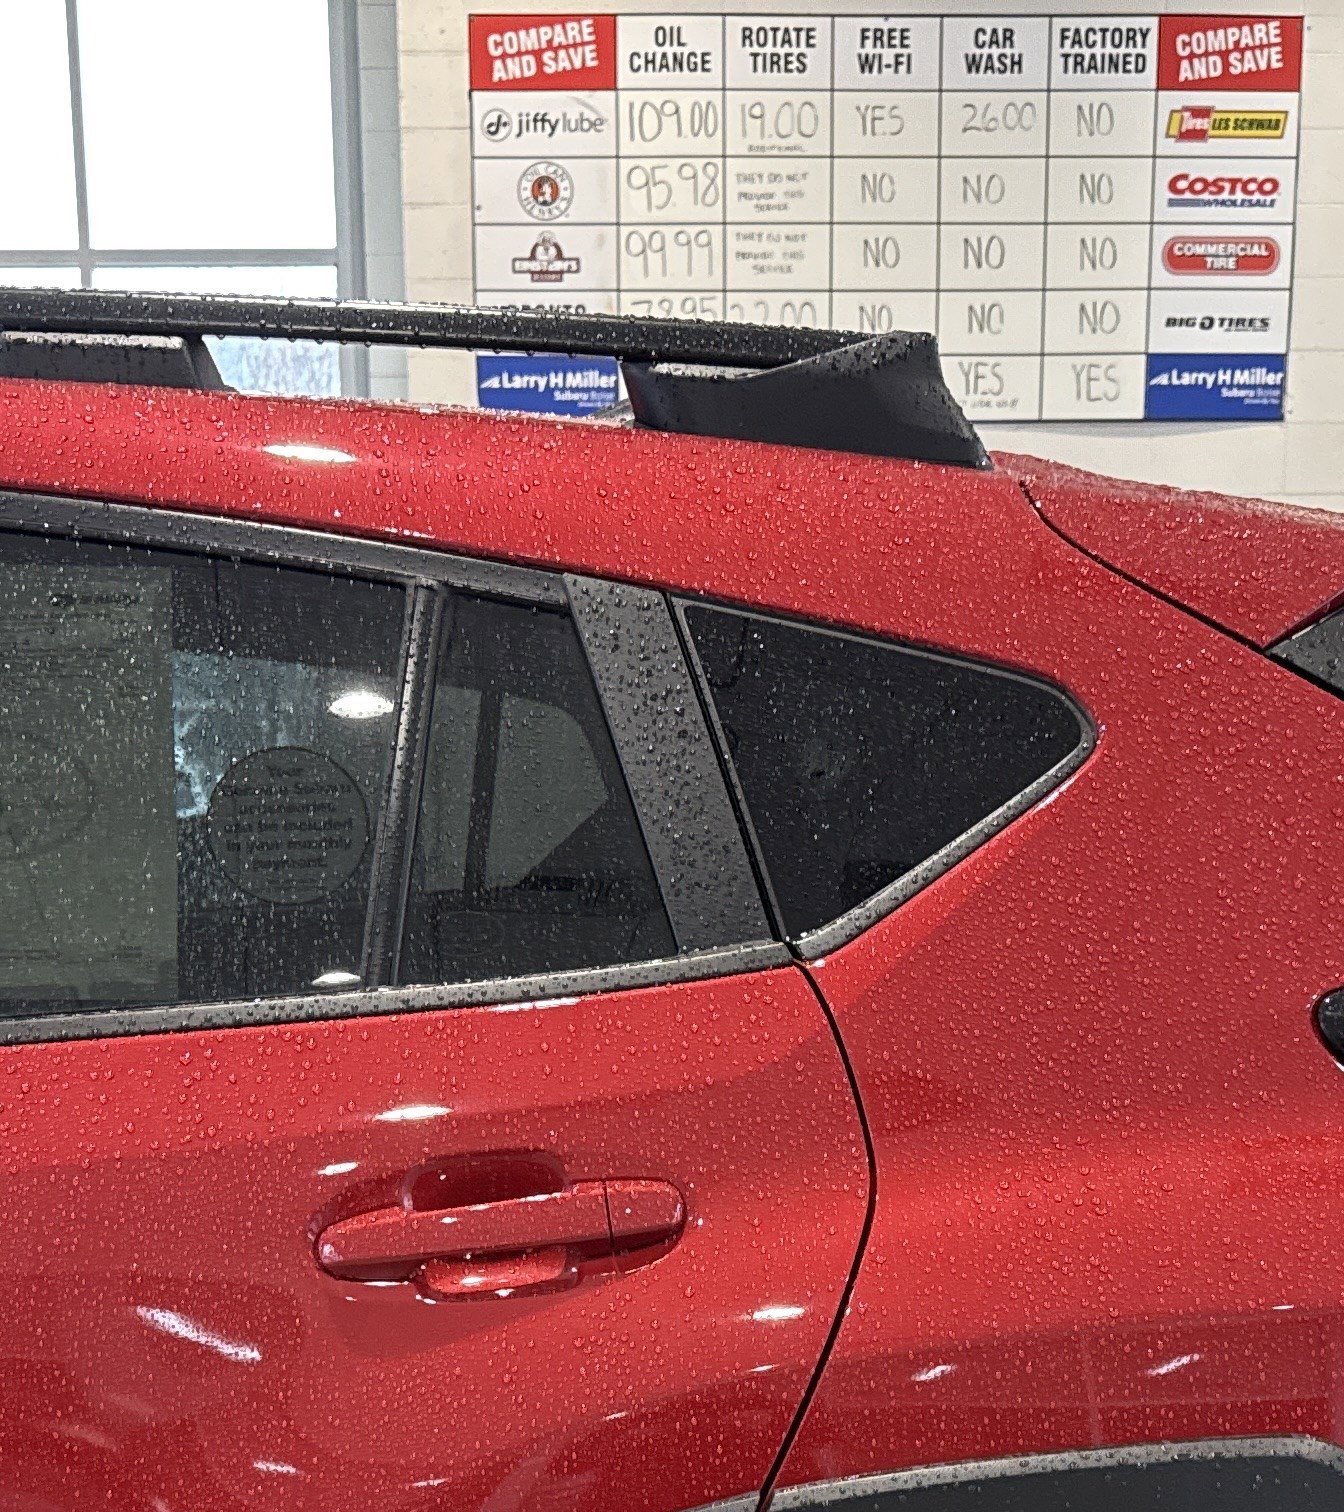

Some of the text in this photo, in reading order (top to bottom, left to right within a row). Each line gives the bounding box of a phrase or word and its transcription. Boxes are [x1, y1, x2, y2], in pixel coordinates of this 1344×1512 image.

[487, 19, 596, 57] COMPARE
[654, 26, 687, 48] OIL
[741, 26, 817, 48] ROTATE
[859, 28, 912, 49] FREE
[973, 28, 1015, 49] CAR
[1059, 28, 1152, 49] FACTORY
[1175, 20, 1283, 57] COMPARE
[492, 44, 599, 82] AND SAVE
[629, 52, 712, 74] CHANGE
[749, 52, 808, 74] TIRES
[857, 53, 913, 74] WI-FI
[964, 53, 1023, 74] WASH
[1060, 53, 1148, 75] TRAINED
[1178, 46, 1284, 83] AND SAVE
[516, 112, 605, 138] jiffy lube
[740, 101, 819, 140] 19.00
[855, 104, 906, 137] YES
[1076, 102, 1115, 138] NO
[860, 172, 897, 204] NO
[962, 172, 1006, 205] NO
[1079, 172, 1114, 205] NO
[1167, 173, 1280, 196] COSTCO
[863, 236, 901, 269] NO
[963, 235, 1006, 269] NO
[1079, 237, 1118, 271] NO
[1172, 243, 1271, 256] COMMERCIAL
[1205, 257, 1238, 269] TIRE
[858, 304, 894, 333] NO
[968, 303, 1005, 335] NO
[1078, 300, 1121, 335] NO
[1164, 316, 1271, 330] BIG O TIRES
[501, 370, 618, 392] Larry H Miller
[958, 361, 1005, 397] YES
[1071, 363, 1121, 402] YES
[1171, 367, 1285, 389] Larry H Miller
